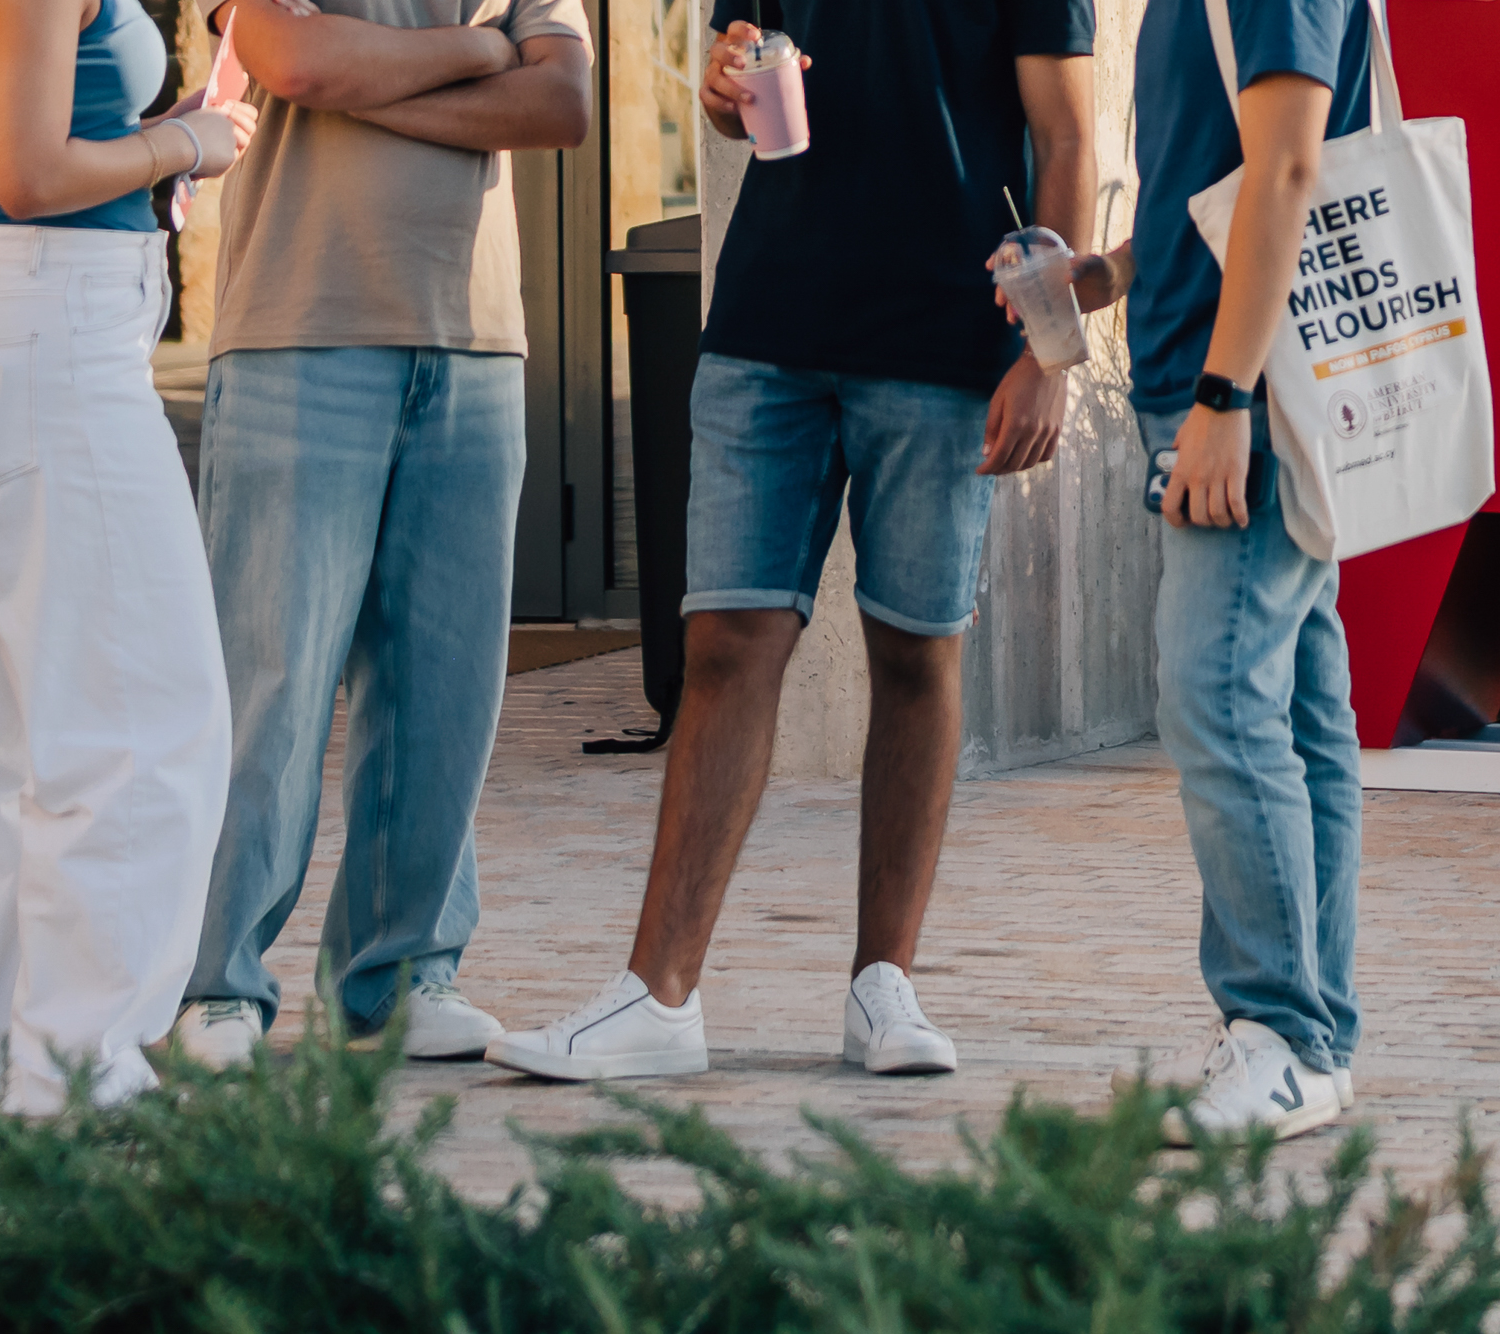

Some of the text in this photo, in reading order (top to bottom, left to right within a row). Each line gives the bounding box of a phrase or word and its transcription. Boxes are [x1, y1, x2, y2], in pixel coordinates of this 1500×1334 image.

[1304, 186, 1390, 239] HERE
[1299, 233, 1363, 277] REE
[1288, 260, 1399, 318] MINDS
[1297, 276, 1462, 351] FLOURISH
[1328, 355, 1355, 374] NOW
[1355, 352, 1369, 366] IN
[1369, 339, 1407, 363] PAFOS
